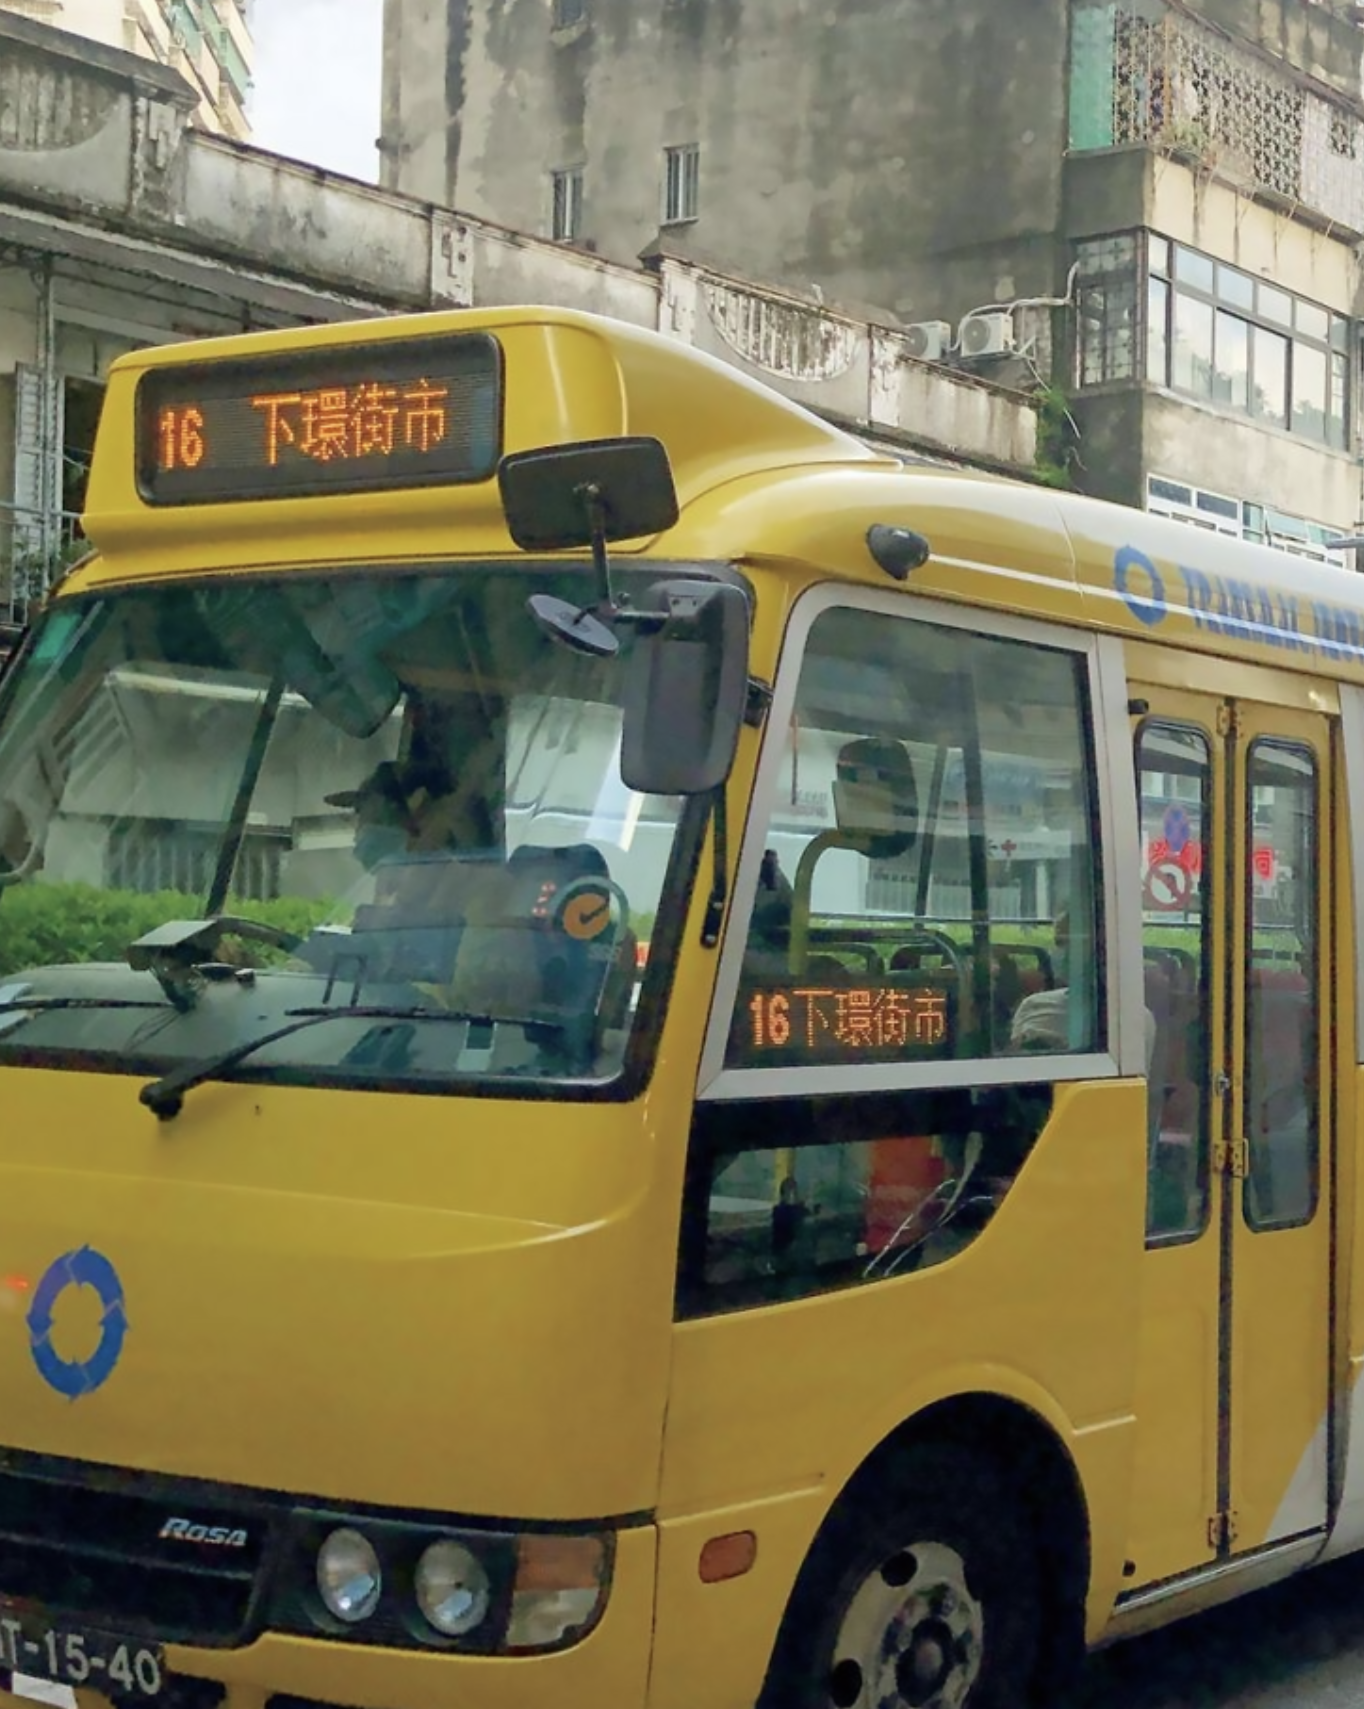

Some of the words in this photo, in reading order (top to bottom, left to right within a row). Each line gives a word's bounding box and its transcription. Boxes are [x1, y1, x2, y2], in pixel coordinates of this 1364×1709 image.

[159, 408, 204, 469] 16
[252, 377, 449, 466] 下環街市
[749, 993, 790, 1046] 16
[793, 987, 946, 1047] 下環街市
[0, 1617, 162, 1695] T-15-40
